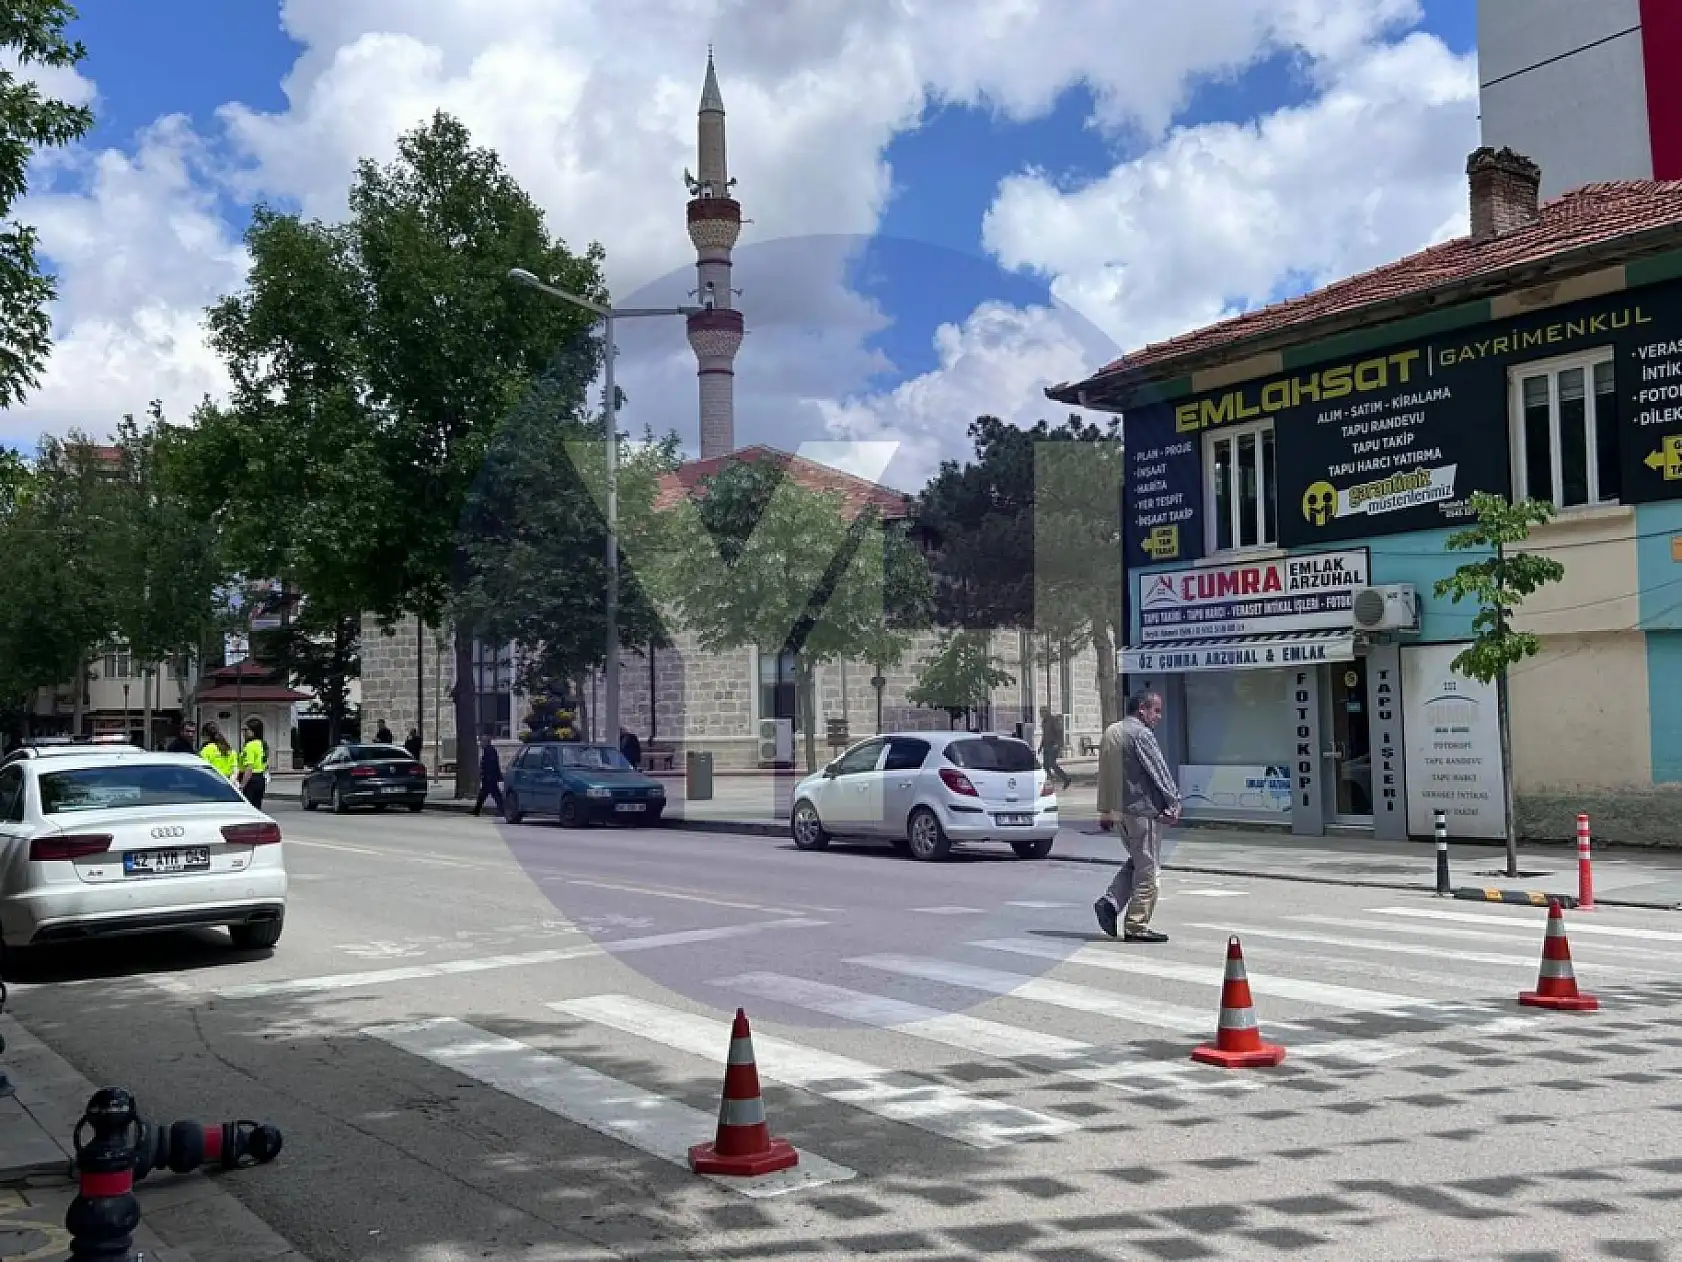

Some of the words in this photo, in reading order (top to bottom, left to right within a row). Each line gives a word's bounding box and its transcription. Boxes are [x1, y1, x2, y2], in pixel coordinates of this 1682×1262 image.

[1439, 306, 1651, 366] GAYRİMENKUL
[1317, 409, 1342, 424] ALIM
[1350, 400, 1383, 418] SATIM
[1392, 385, 1451, 409] KİRALAMA
[1341, 421, 1368, 438] TAPU
[1370, 410, 1425, 433] RANDEVU
[1352, 438, 1380, 455] TAPU
[1382, 431, 1415, 450] TAKİP
[1328, 461, 1356, 477] TAPU
[1358, 455, 1391, 473] HARCI
[1393, 446, 1443, 467] YATIRMA
[1289, 557, 1345, 577] EMLAK
[1289, 569, 1364, 590] ARZUHAL
[1139, 652, 1153, 669] ÖZ
[1159, 652, 1199, 670] ÇUMRA
[1205, 650, 1258, 665] ARZUHAL
[1265, 648, 1275, 662] &
[1283, 646, 1326, 662] EMLAK
[1377, 669, 1392, 720] TAPU
